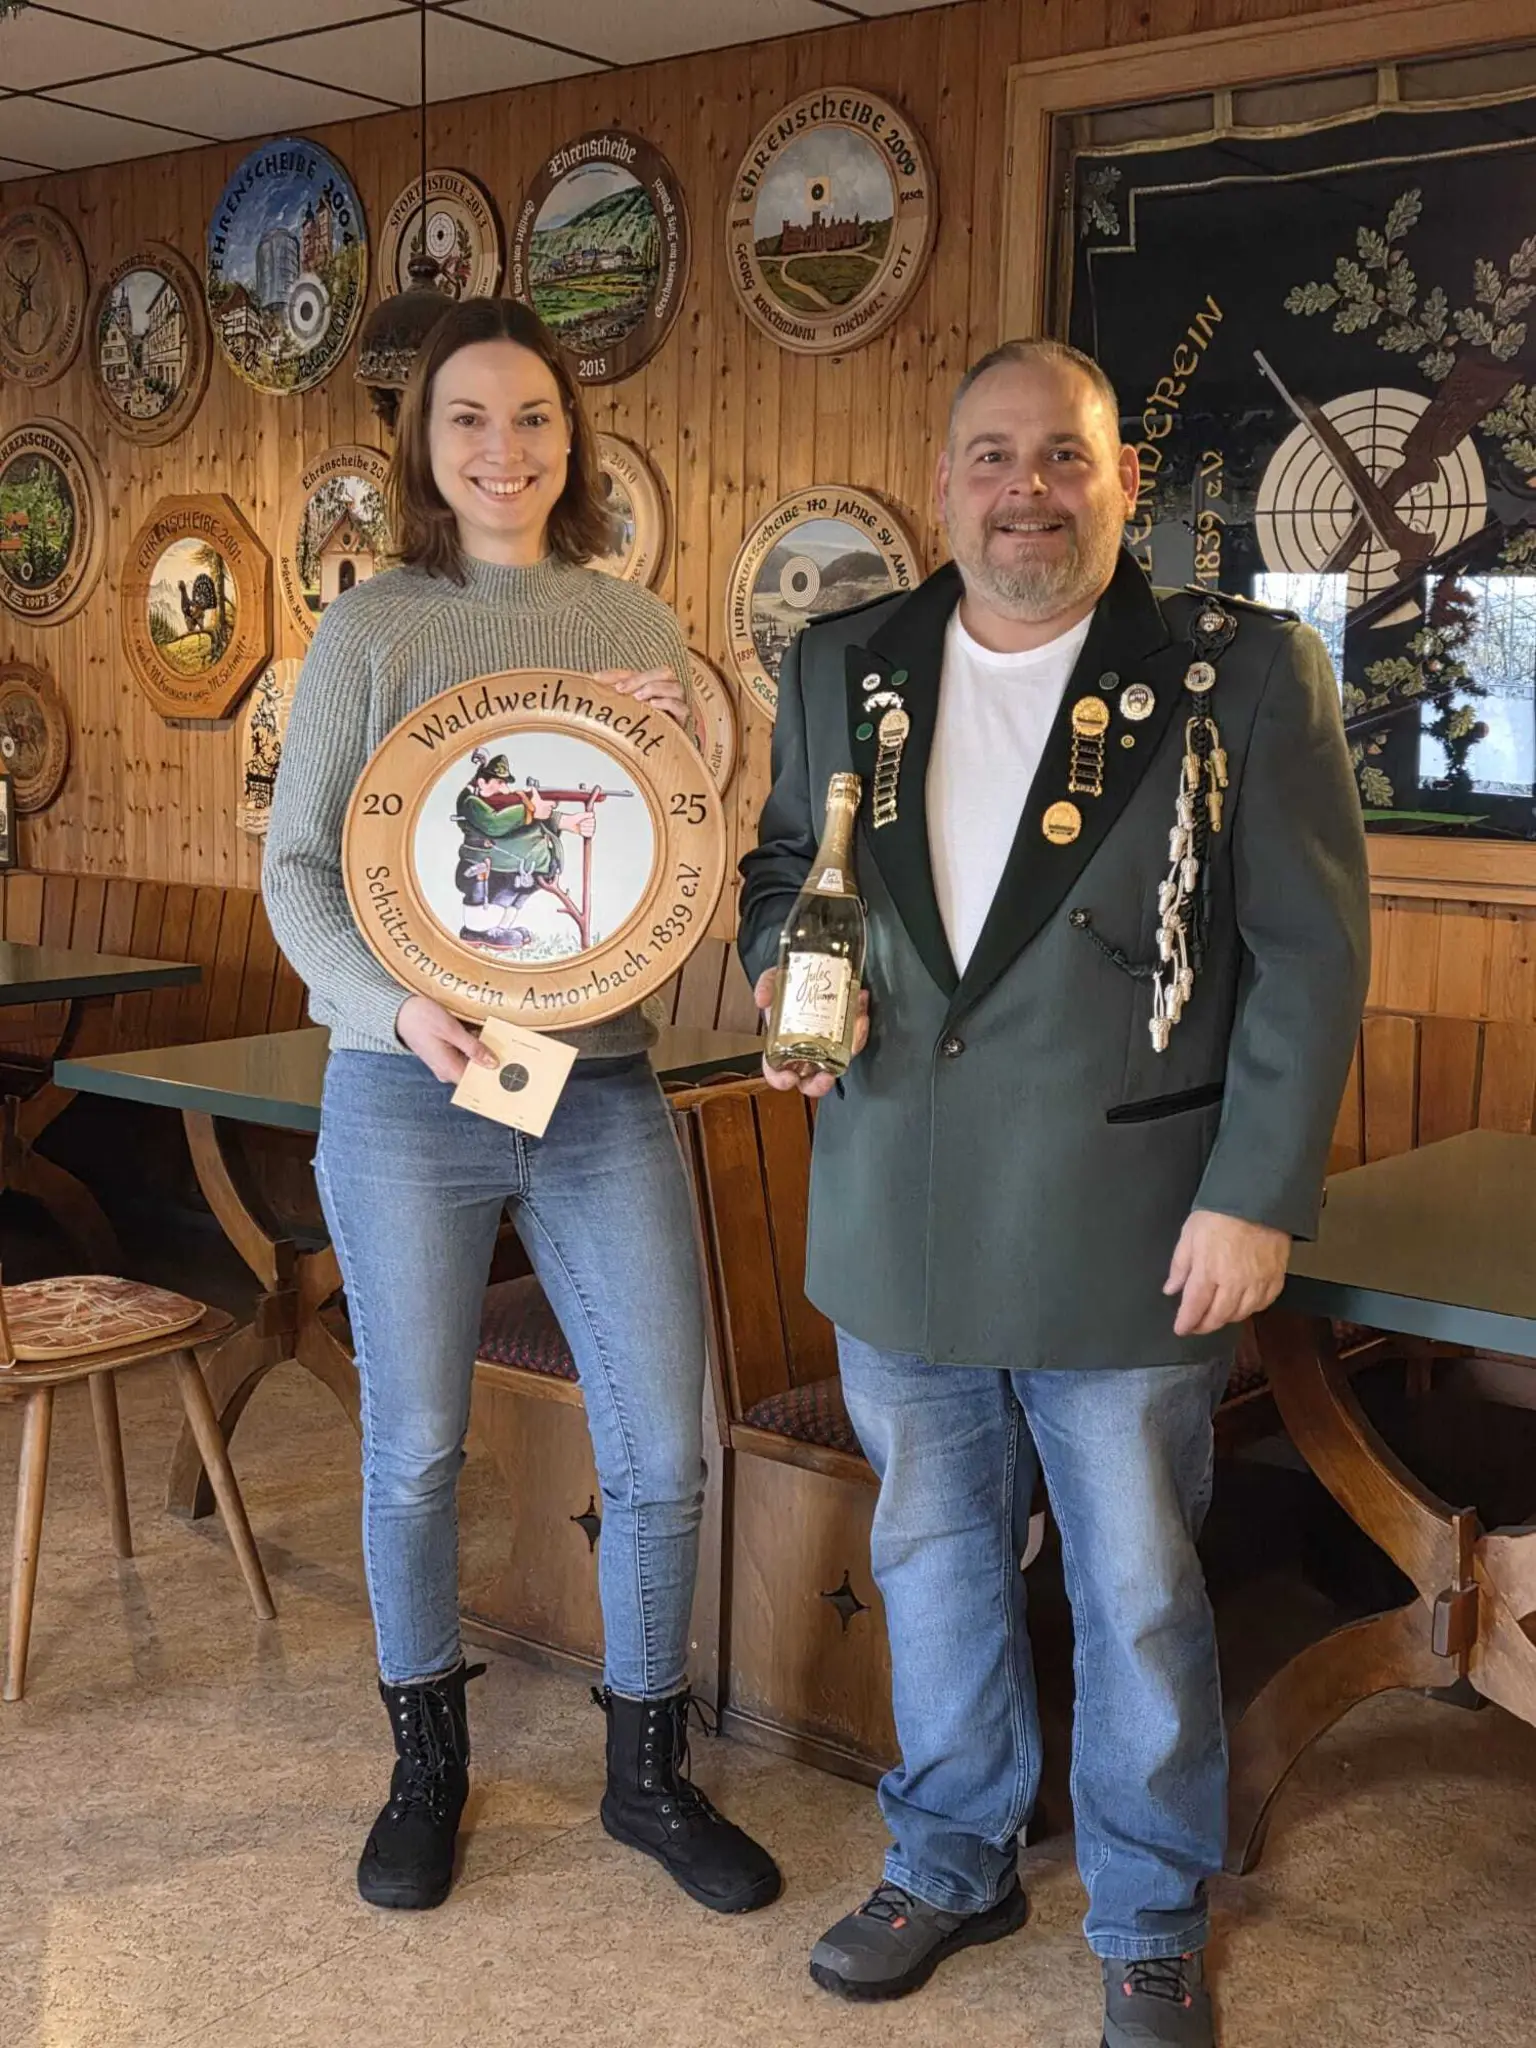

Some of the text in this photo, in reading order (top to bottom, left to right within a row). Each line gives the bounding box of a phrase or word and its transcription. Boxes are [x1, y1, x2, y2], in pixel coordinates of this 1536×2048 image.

[547, 135, 637, 178] Ehrenscheibe
[211, 150, 319, 271] EHRENSCHEIBE
[390, 174, 466, 228] SPORTISTOLE
[0, 432, 73, 469] HRENSCHEIBE
[302, 453, 369, 491] Ehrenscheibe
[138, 511, 221, 568] EHRENSCHEIBE
[877, 528, 895, 546] SV
[1194, 508, 1227, 588] 1839
[407, 679, 667, 758] Waldweihnacht
[363, 793, 402, 817] 20
[670, 793, 707, 824] 25
[365, 865, 504, 1009] Schützenverein
[520, 949, 651, 1011] Amorbach
[649, 904, 695, 957] 1839
